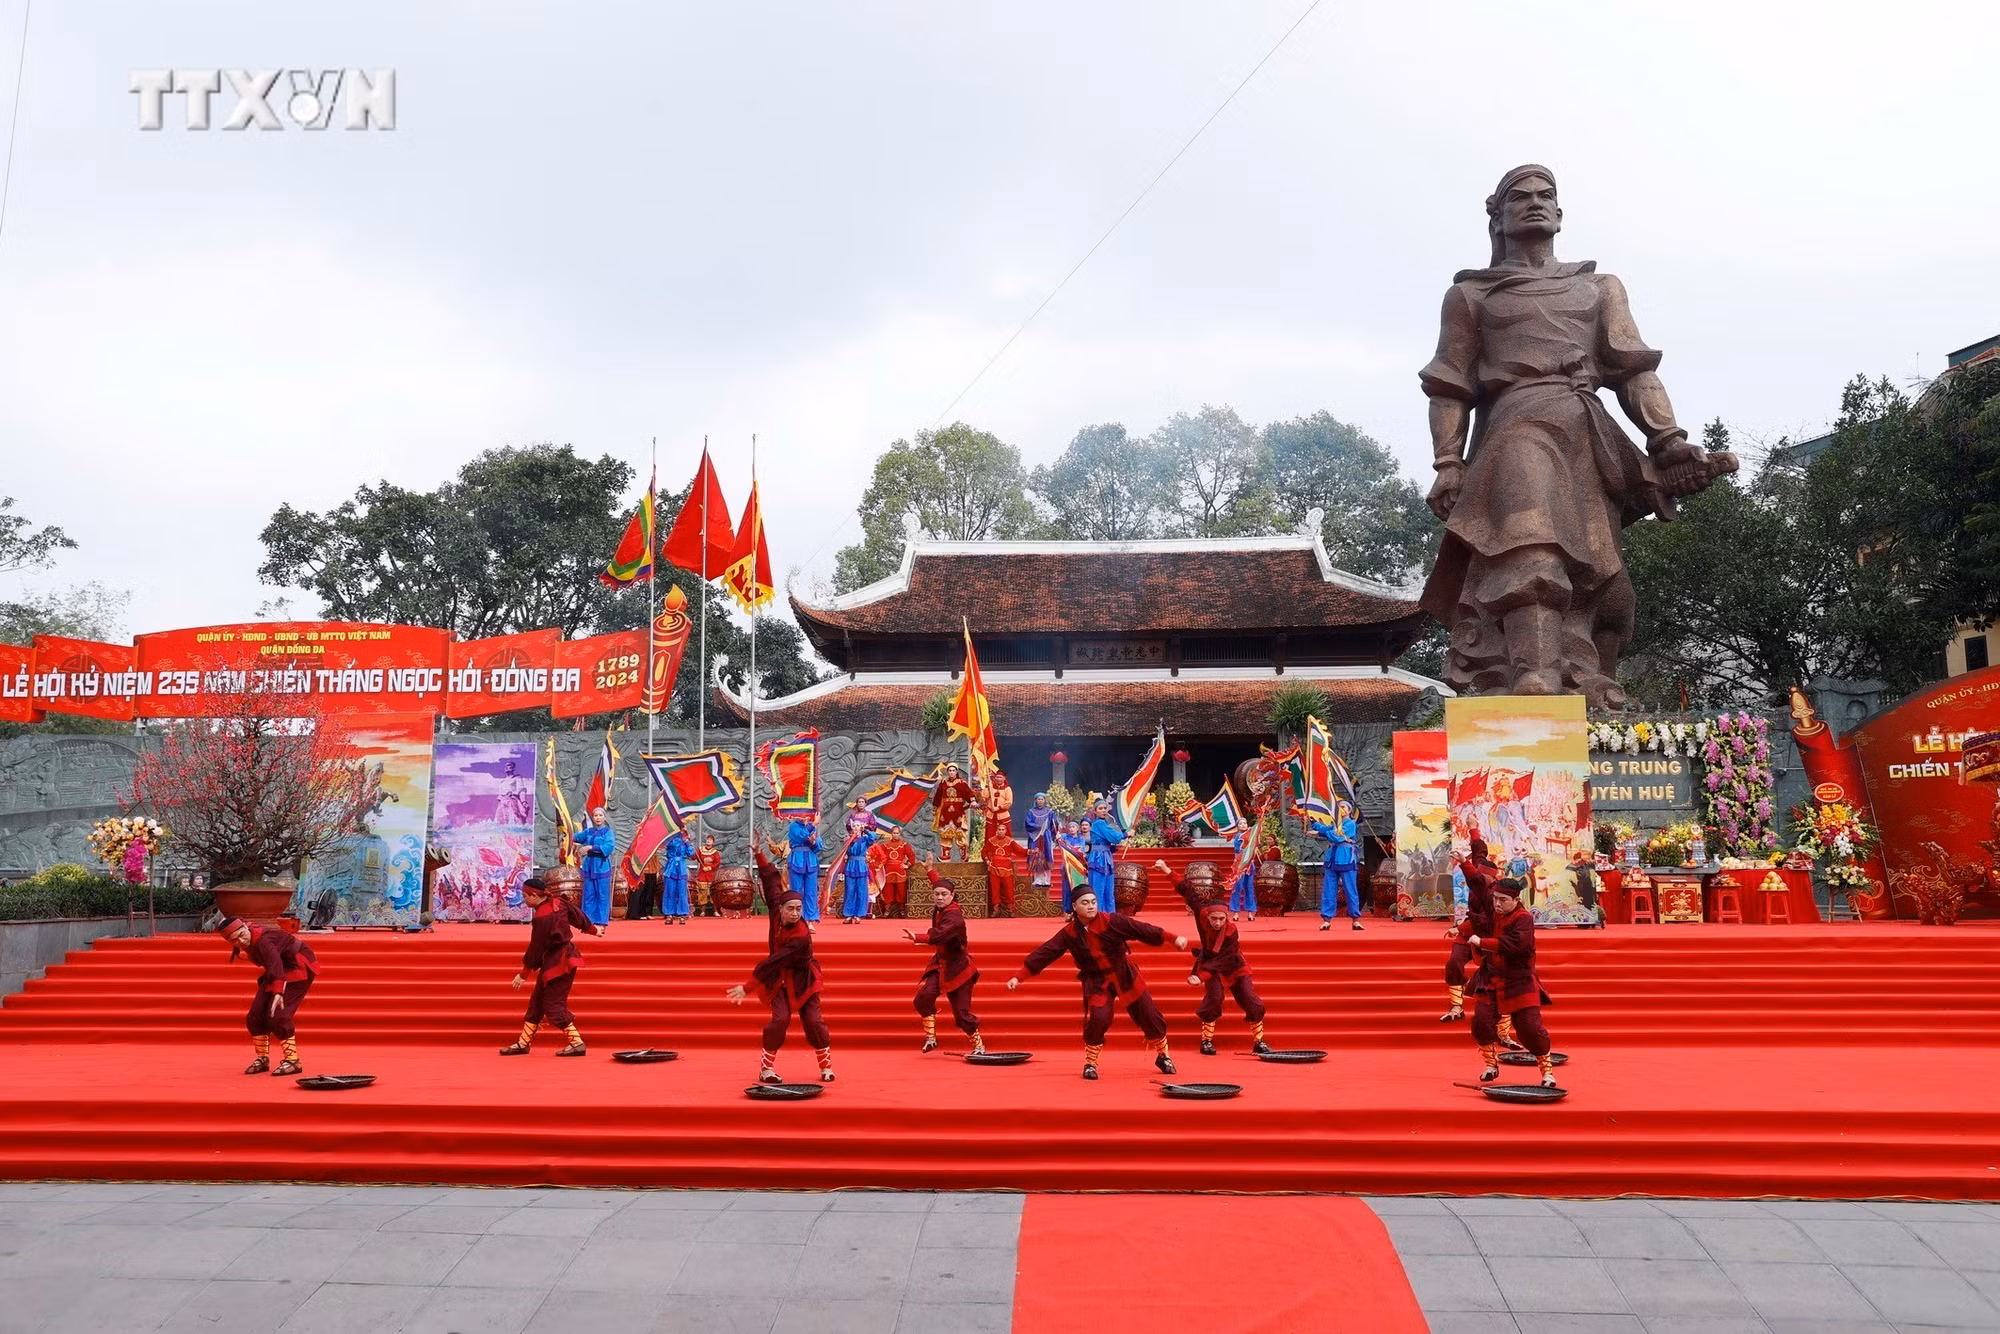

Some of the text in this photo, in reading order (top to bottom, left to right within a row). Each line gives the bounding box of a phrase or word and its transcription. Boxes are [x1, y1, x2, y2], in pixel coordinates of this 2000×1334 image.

[196, 632, 221, 643] QUẬN
[274, 632, 299, 641] UBND
[306, 632, 319, 640] UB
[320, 632, 346, 641] MTTQ
[347, 630, 368, 641] VIỆT
[369, 631, 391, 640] NAM
[260, 644, 285, 655] QUẬN
[597, 653, 640, 673] 1789
[3, 663, 30, 697] LỄ
[33, 666, 66, 703] HỘI
[103, 665, 153, 702] NIỆM
[157, 671, 200, 695] 235
[203, 665, 246, 694] NĂM
[250, 658, 312, 694] CHIẾN
[315, 658, 384, 693] THẮNG
[387, 668, 442, 698] NGỌC
[551, 668, 581, 692] ĐA
[595, 669, 639, 689] 2024
[1914, 726, 1944, 753] LỄ
[1589, 760, 1682, 775] NG TRUNG
[1889, 756, 1950, 779] CHIẾN
[1592, 781, 1675, 803] YỄN HUỆ
